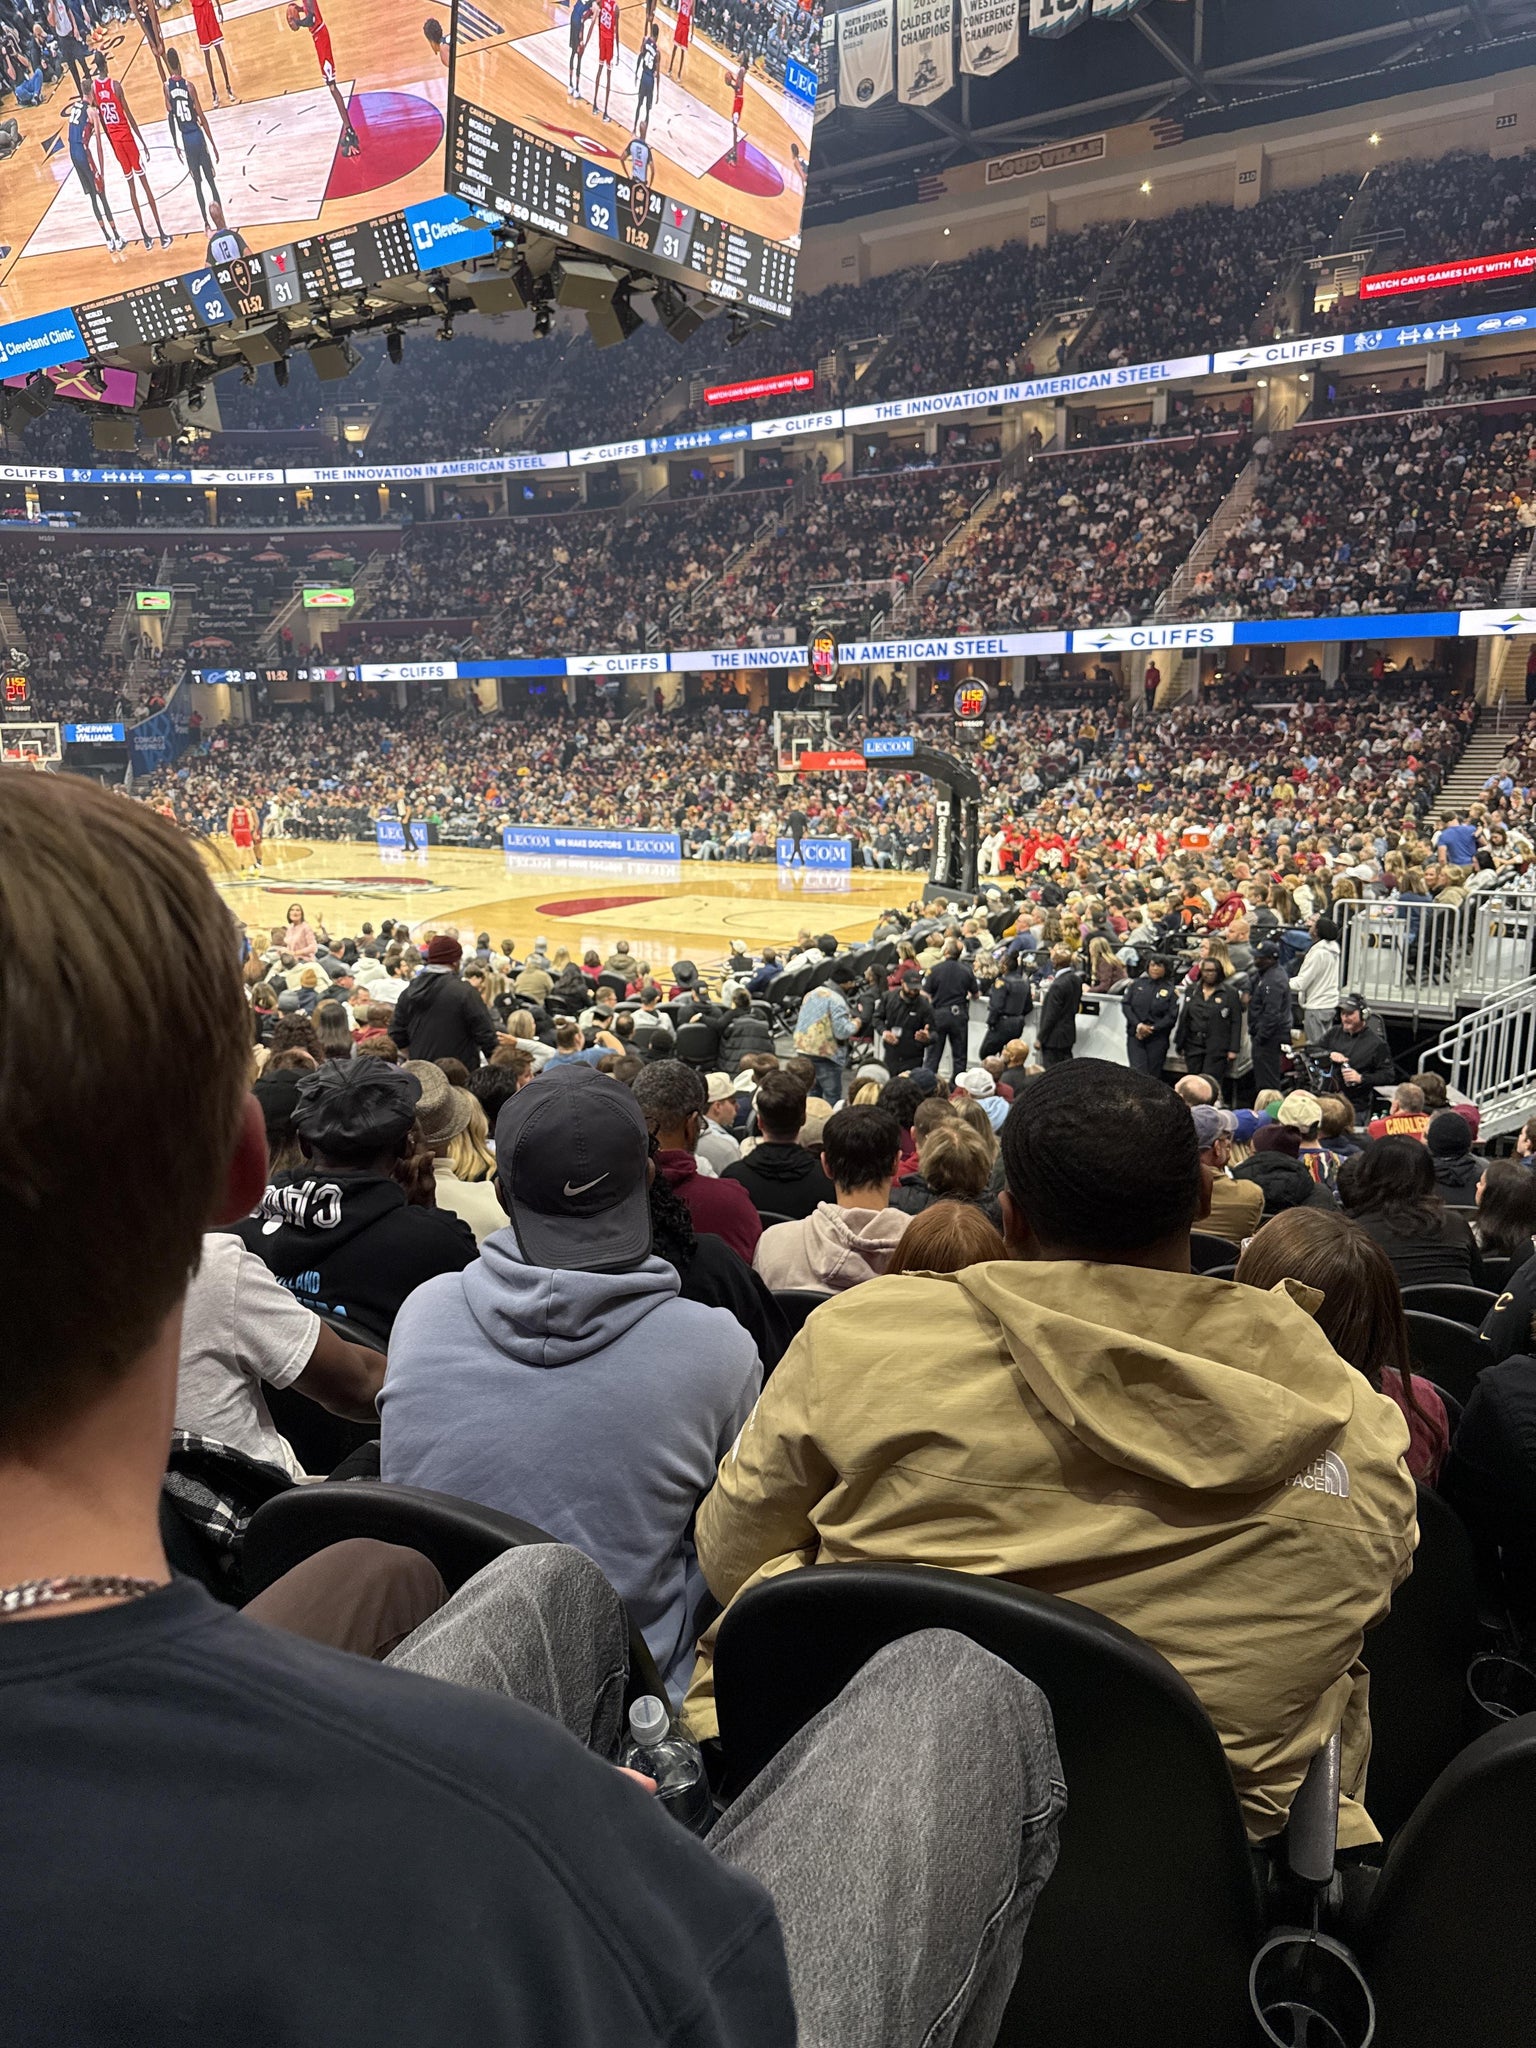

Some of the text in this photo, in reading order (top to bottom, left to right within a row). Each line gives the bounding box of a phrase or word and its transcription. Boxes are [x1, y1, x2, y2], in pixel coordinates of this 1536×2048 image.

[845, 16, 861, 27] NORTH
[863, 9, 886, 21] DIVISION
[901, 5, 950, 31] CALDER CUP
[963, 3, 1016, 27] CONFERENCE
[843, 17, 888, 39] CHAMPIONS
[901, 21, 950, 47] CHAMPIONS
[965, 20, 1013, 42] CHAMPIONS
[101, 102, 119, 124] 25
[176, 99, 192, 122] 45
[468, 118, 492, 136] MOBLEY
[649, 195, 661, 214] 24
[530, 211, 569, 237] RAFFLE
[590, 204, 609, 230] 32
[626, 226, 649, 250] 11:52
[663, 235, 679, 258] 31
[249, 259, 261, 275] 24
[1366, 278, 1399, 292] WATCH
[1400, 275, 1426, 286] CAVS
[1427, 269, 1462, 281] GAMES
[1463, 265, 1484, 277] LIVE
[1486, 261, 1511, 272] WITH
[275, 282, 292, 302] 31
[205, 300, 224, 319] 32
[238, 295, 264, 315] 11:52
[6, 328, 76, 355] Cleveland Clinic
[1266, 340, 1335, 361] CLIFFS
[875, 365, 1170, 418] THE INNOVATION IN AMERICAN STEEL
[785, 416, 833, 431] CLIFFS
[599, 444, 639, 459] CLIFFS
[4, 468, 58, 479] CLIFFS
[226, 472, 274, 482] CLIFFS
[314, 456, 546, 480] THE INNOVATION IN AMERICAN STEEL
[1131, 628, 1214, 646] CLIFFS
[712, 639, 1008, 666] THE INNOVAT IN AMERICAN STEEL
[400, 666, 444, 678] CLIFFS
[606, 658, 658, 671] CLIFFS
[226, 671, 241, 682] 32
[266, 671, 288, 681] 11:52
[6, 686, 26, 700] 24
[961, 700, 981, 714] 24
[76, 724, 113, 733] SHERWIN
[867, 742, 911, 752] LECOM
[380, 826, 425, 841] LECM
[507, 834, 550, 848] LECOM
[588, 840, 622, 849] DOCTORS
[626, 839, 674, 853] LECOM
